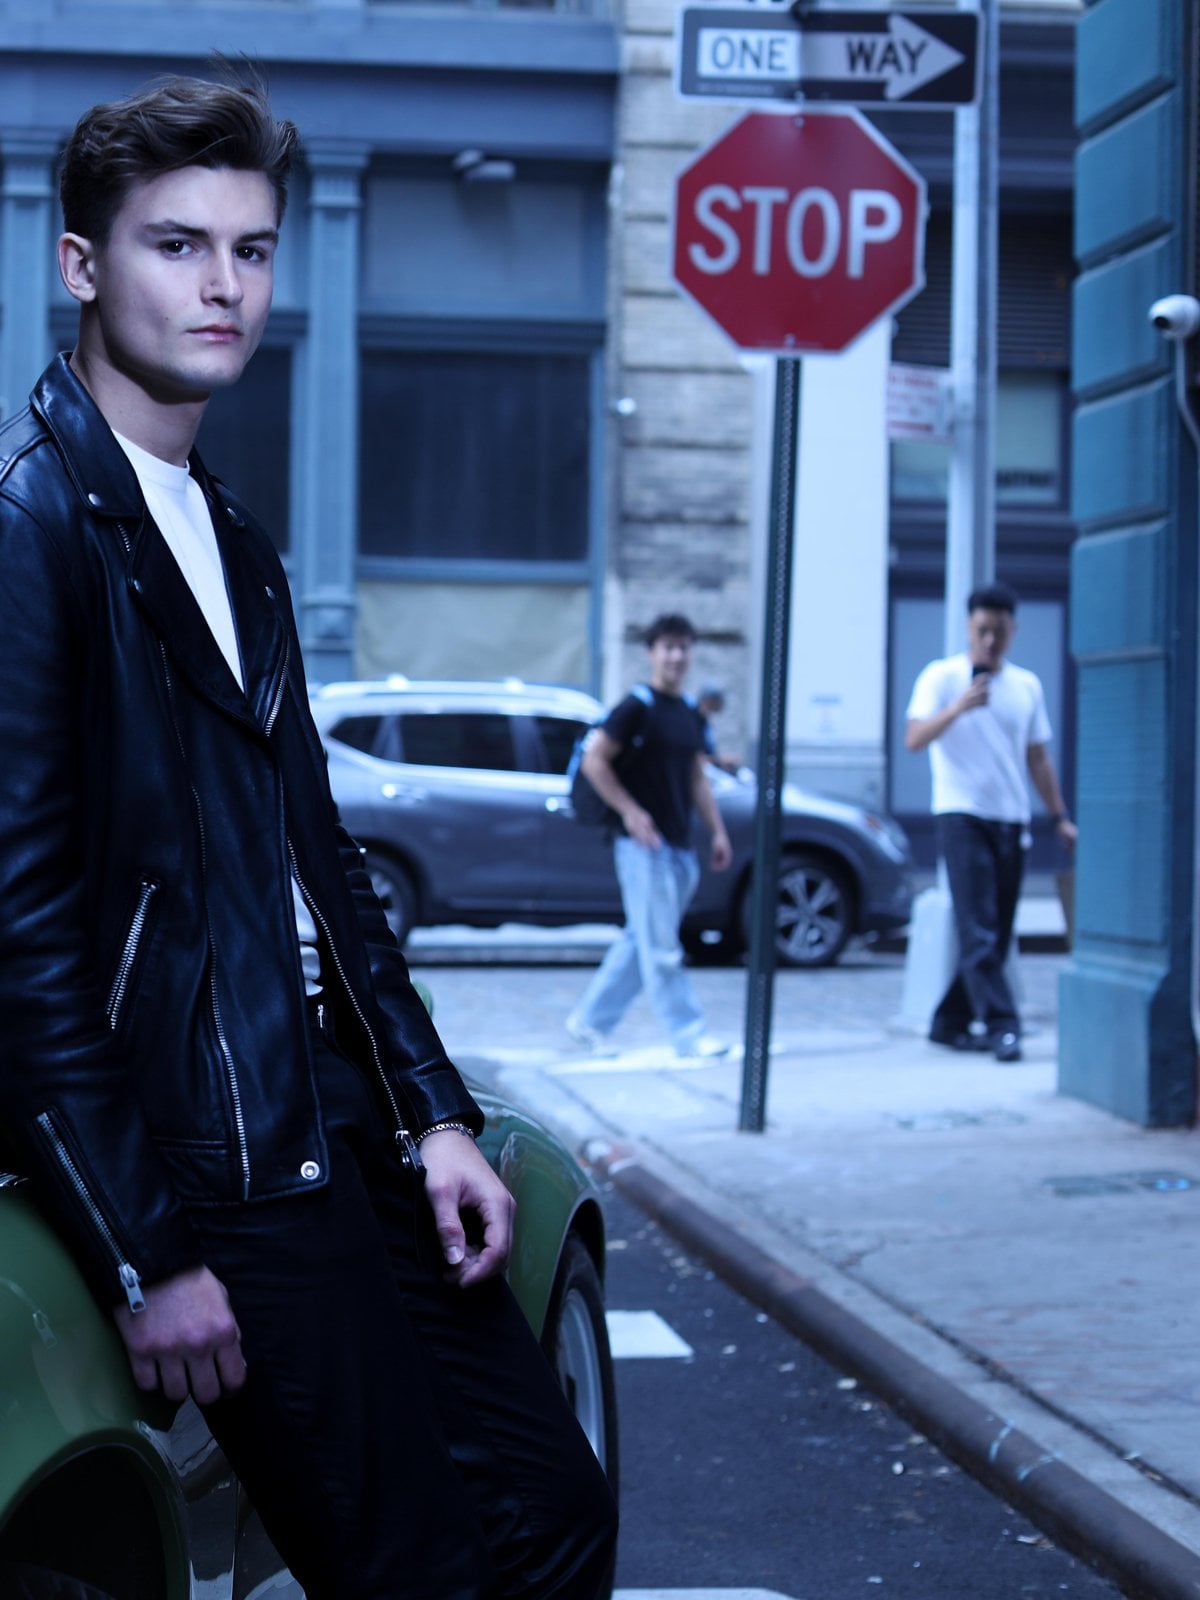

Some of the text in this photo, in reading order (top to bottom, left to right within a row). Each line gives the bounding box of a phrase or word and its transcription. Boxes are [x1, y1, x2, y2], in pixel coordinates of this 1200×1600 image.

[711, 36, 927, 73] ONE WAY
[689, 184, 903, 279] STOP
